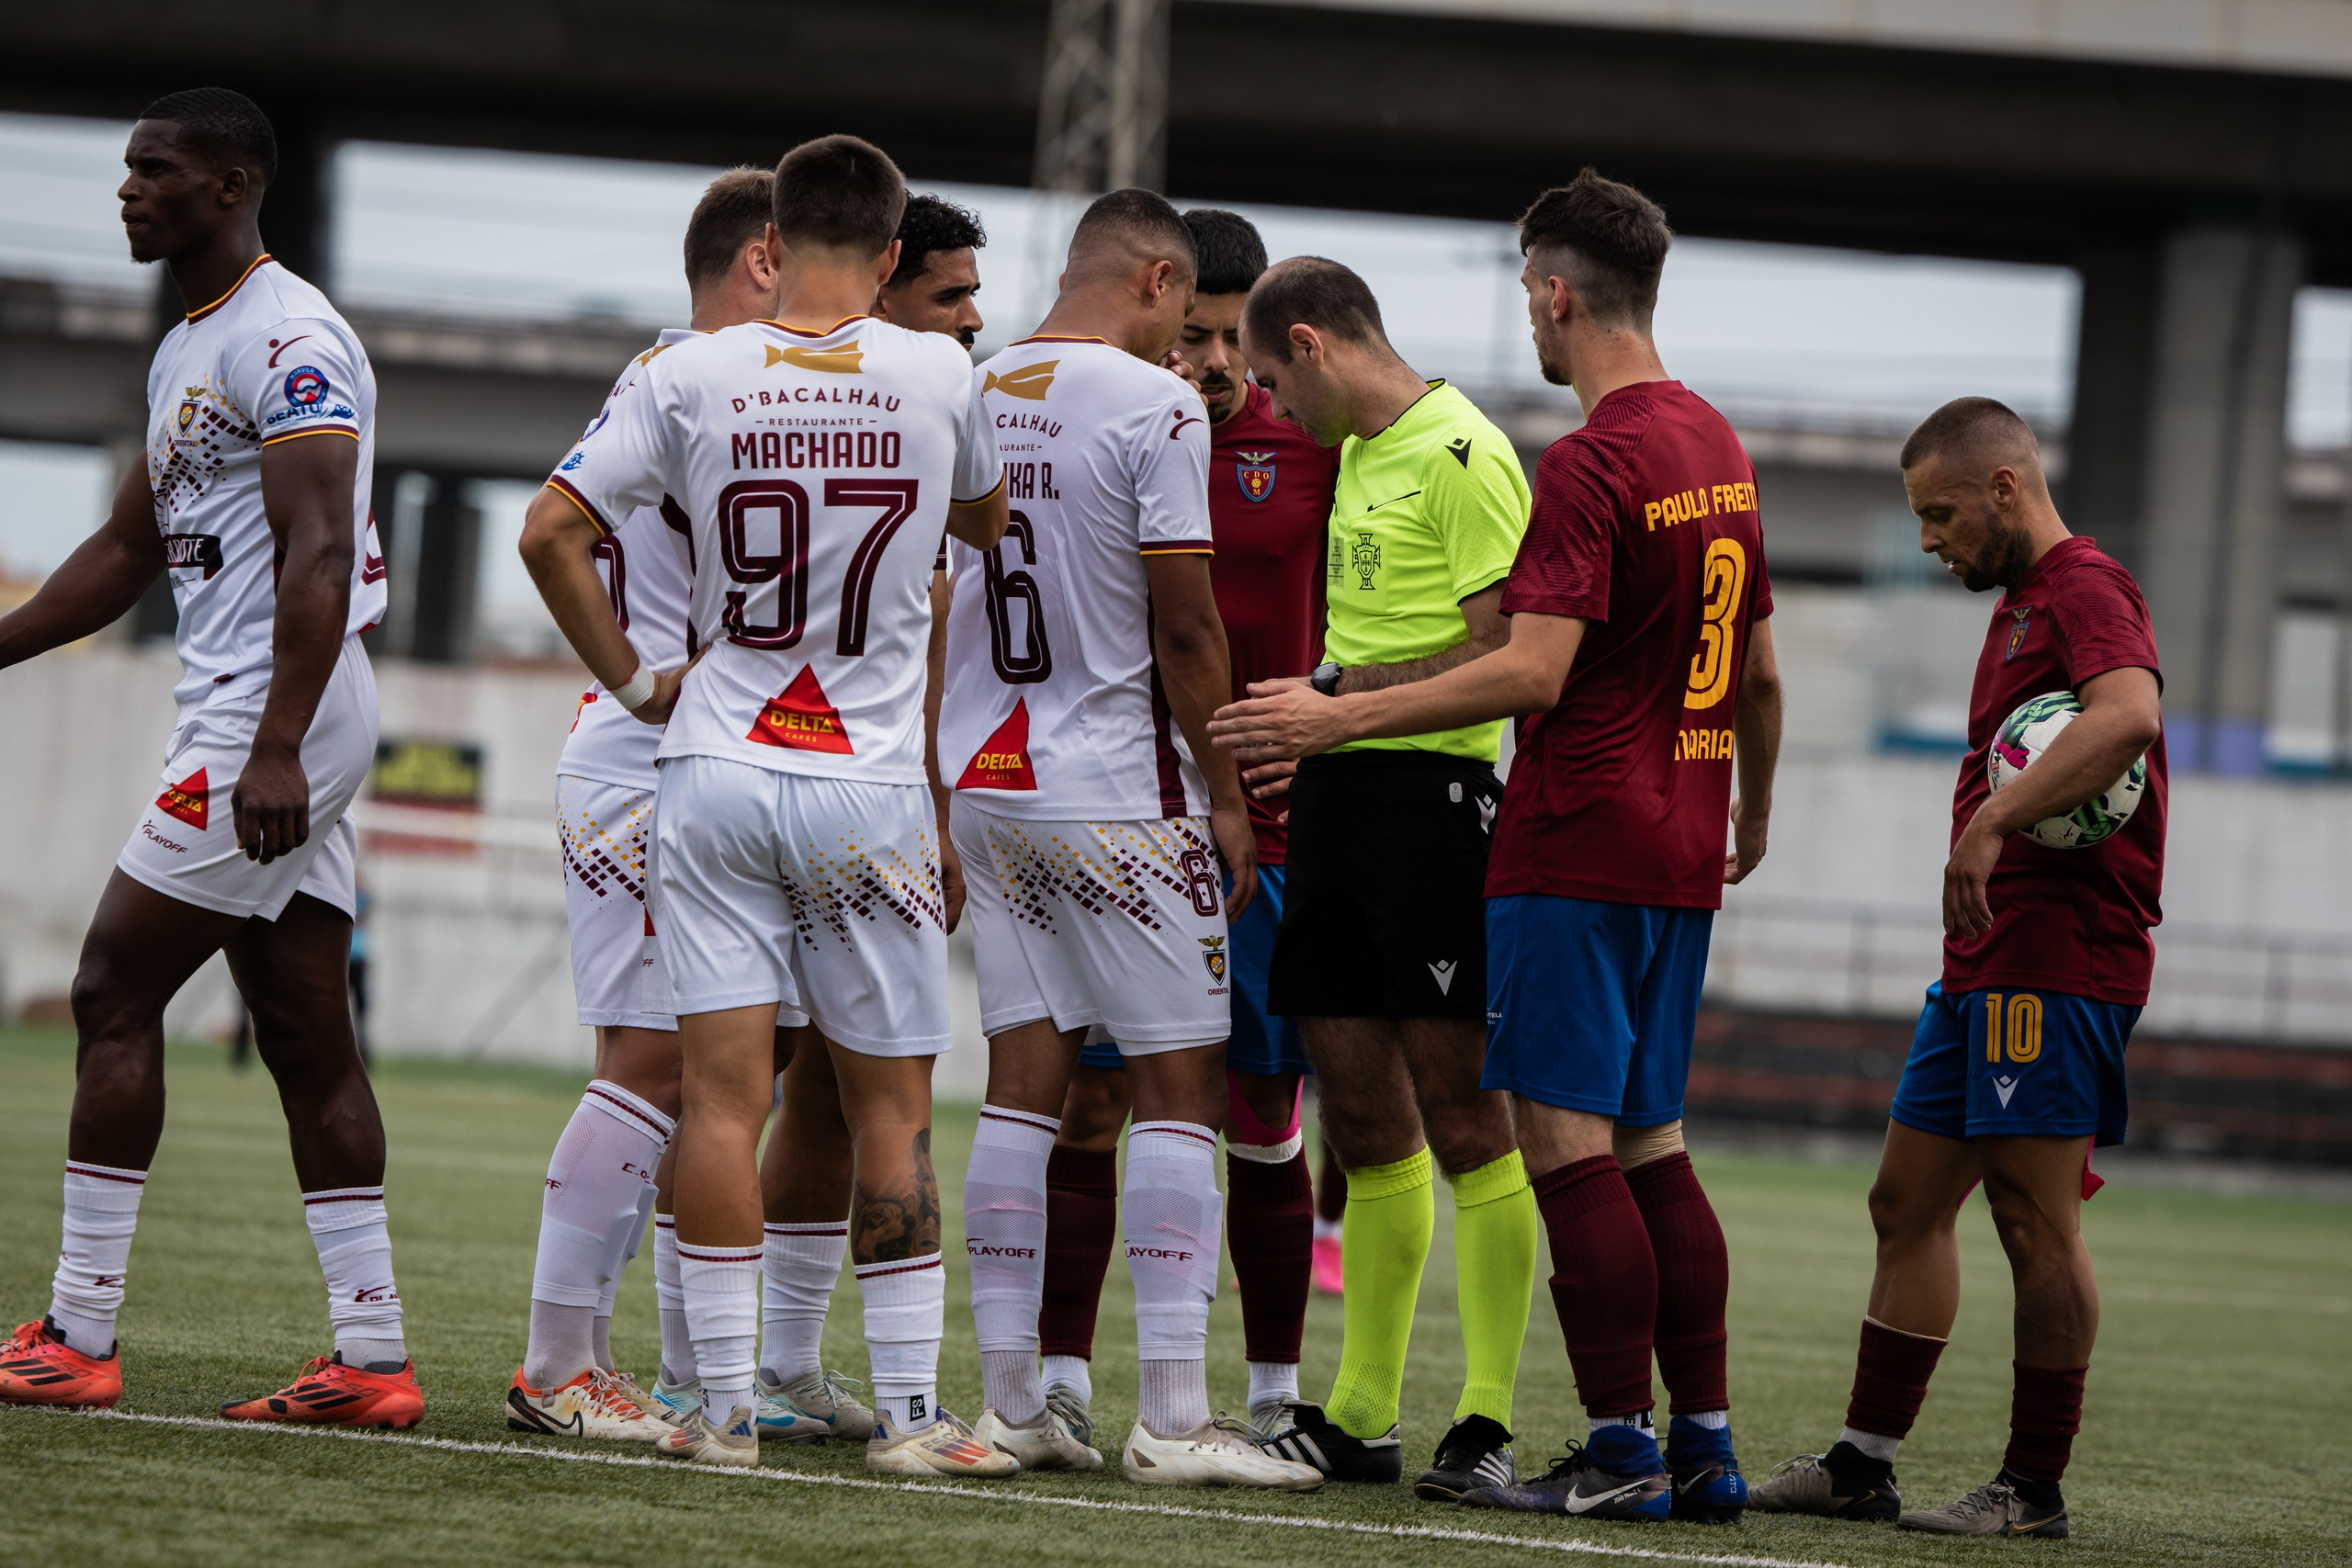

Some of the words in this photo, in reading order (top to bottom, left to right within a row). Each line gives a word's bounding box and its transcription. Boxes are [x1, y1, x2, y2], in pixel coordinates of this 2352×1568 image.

[289, 367, 314, 380] MARVILA
[731, 388, 900, 413] D'BACALHAU
[769, 418, 863, 426] RESTAURANTE
[730, 431, 900, 470] MACHADO
[1003, 462, 1035, 499] KA
[1041, 462, 1059, 500] R.
[1644, 487, 1709, 532] PAULO
[718, 479, 919, 657] 97
[982, 510, 1052, 684] 6
[1683, 537, 1746, 710] 3
[770, 710, 835, 733] DELTA
[785, 732, 817, 742] CAFÉS
[976, 753, 1023, 770] DELTA
[142, 828, 188, 853] PLAYOFF
[1180, 849, 1219, 917] 6
[1985, 993, 2043, 1063] 10
[968, 1246, 1037, 1259] PLAYOFF
